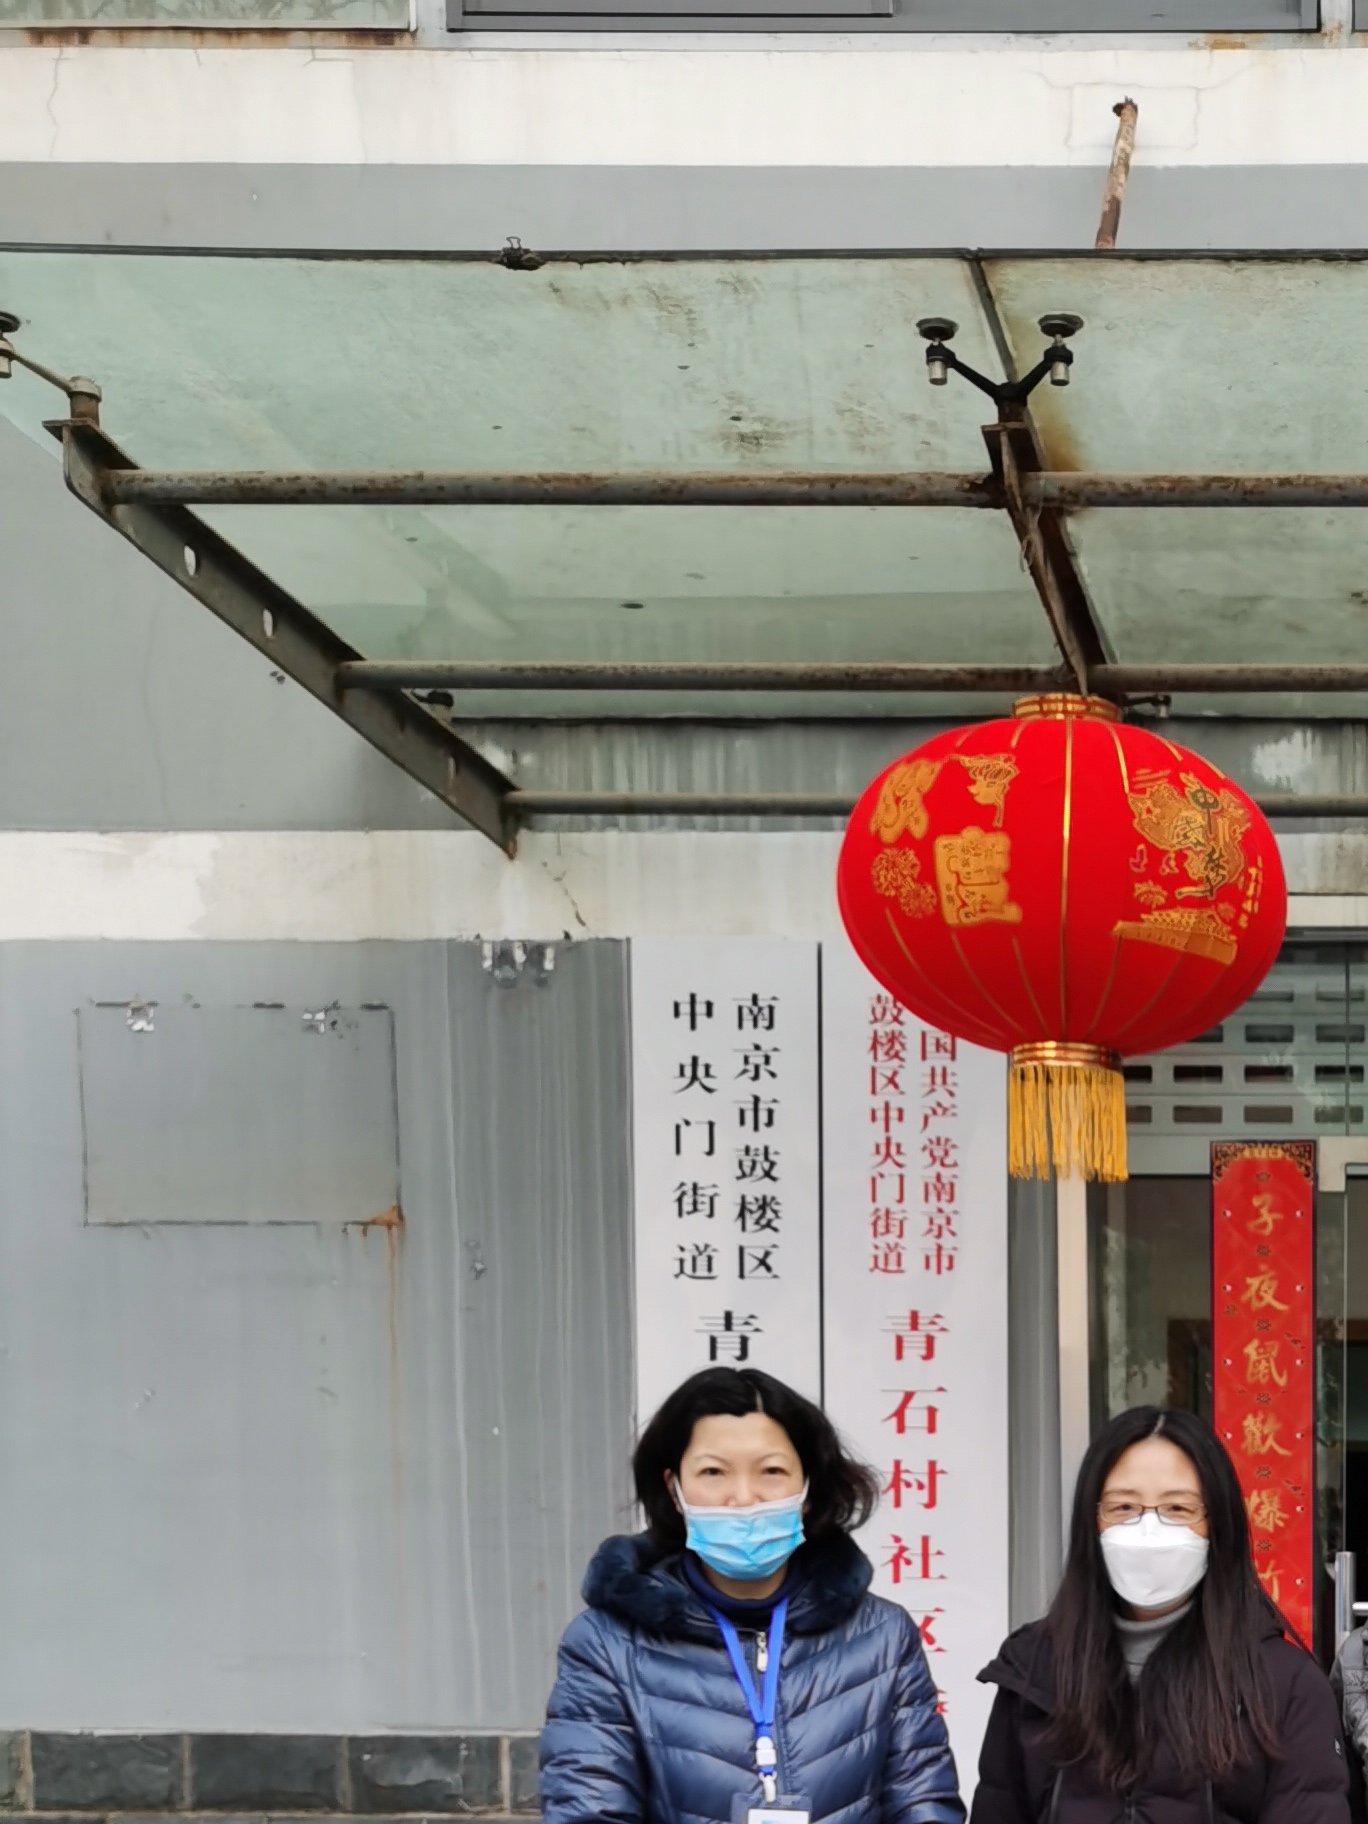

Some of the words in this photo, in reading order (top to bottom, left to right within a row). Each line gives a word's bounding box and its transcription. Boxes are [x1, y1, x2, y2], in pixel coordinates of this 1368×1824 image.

[672, 992, 720, 1281] 中央门街道
[733, 993, 781, 1281] 南京市鼓楼区
[868, 995, 907, 1276] 鼓楼区中央门街道
[881, 1310, 948, 1714] 青石村社
